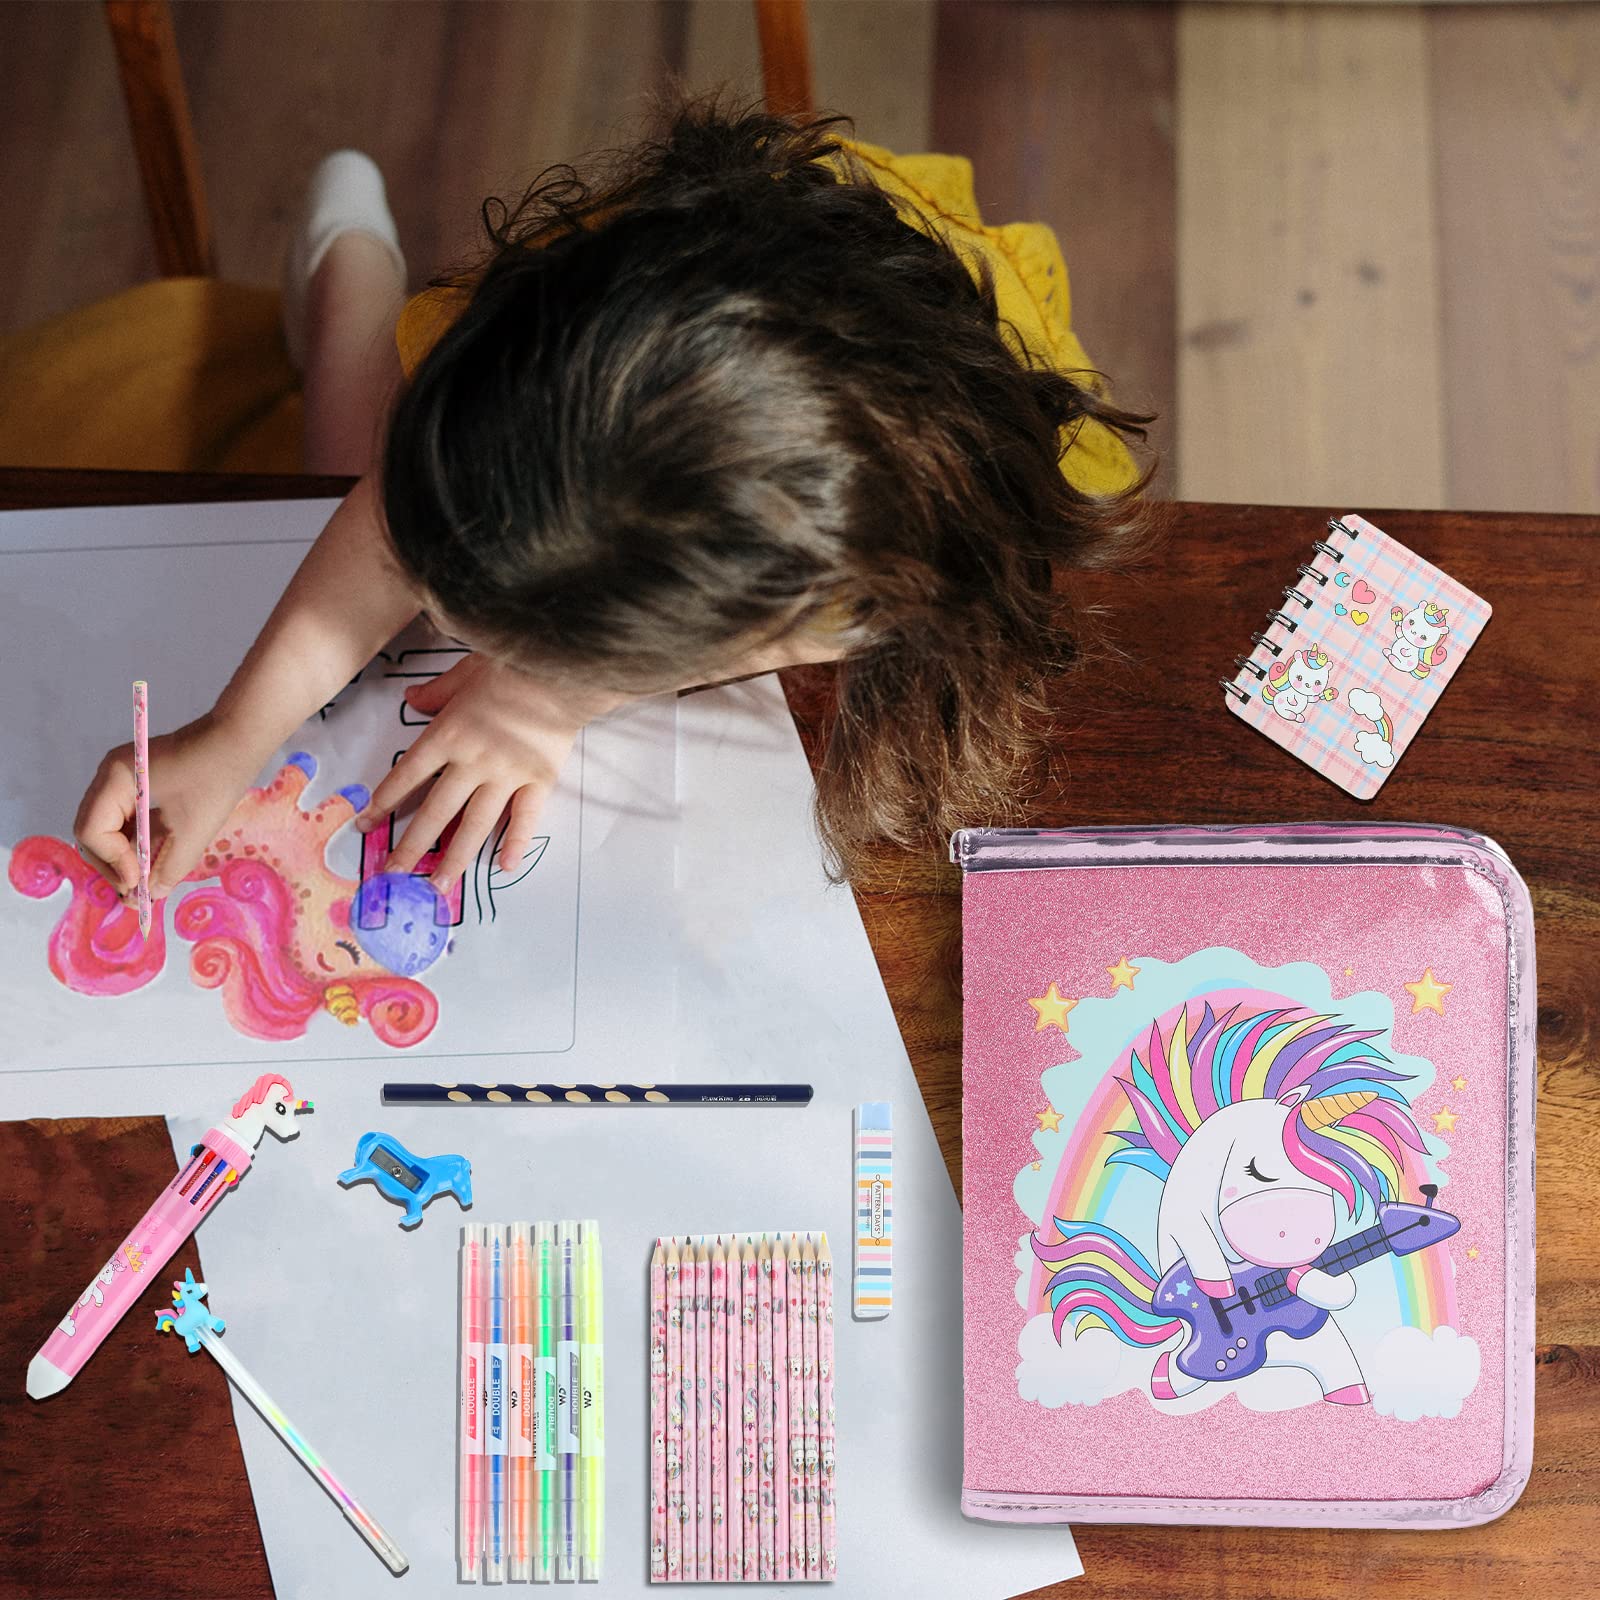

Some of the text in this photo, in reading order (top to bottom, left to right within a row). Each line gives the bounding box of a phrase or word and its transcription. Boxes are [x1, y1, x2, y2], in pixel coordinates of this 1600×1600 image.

[467, 1378, 475, 1415] DOUBLE
[492, 1378, 501, 1416] DOUBLE
[523, 1380, 531, 1417] DOUBLE
[571, 1377, 579, 1415] DOUBLE
